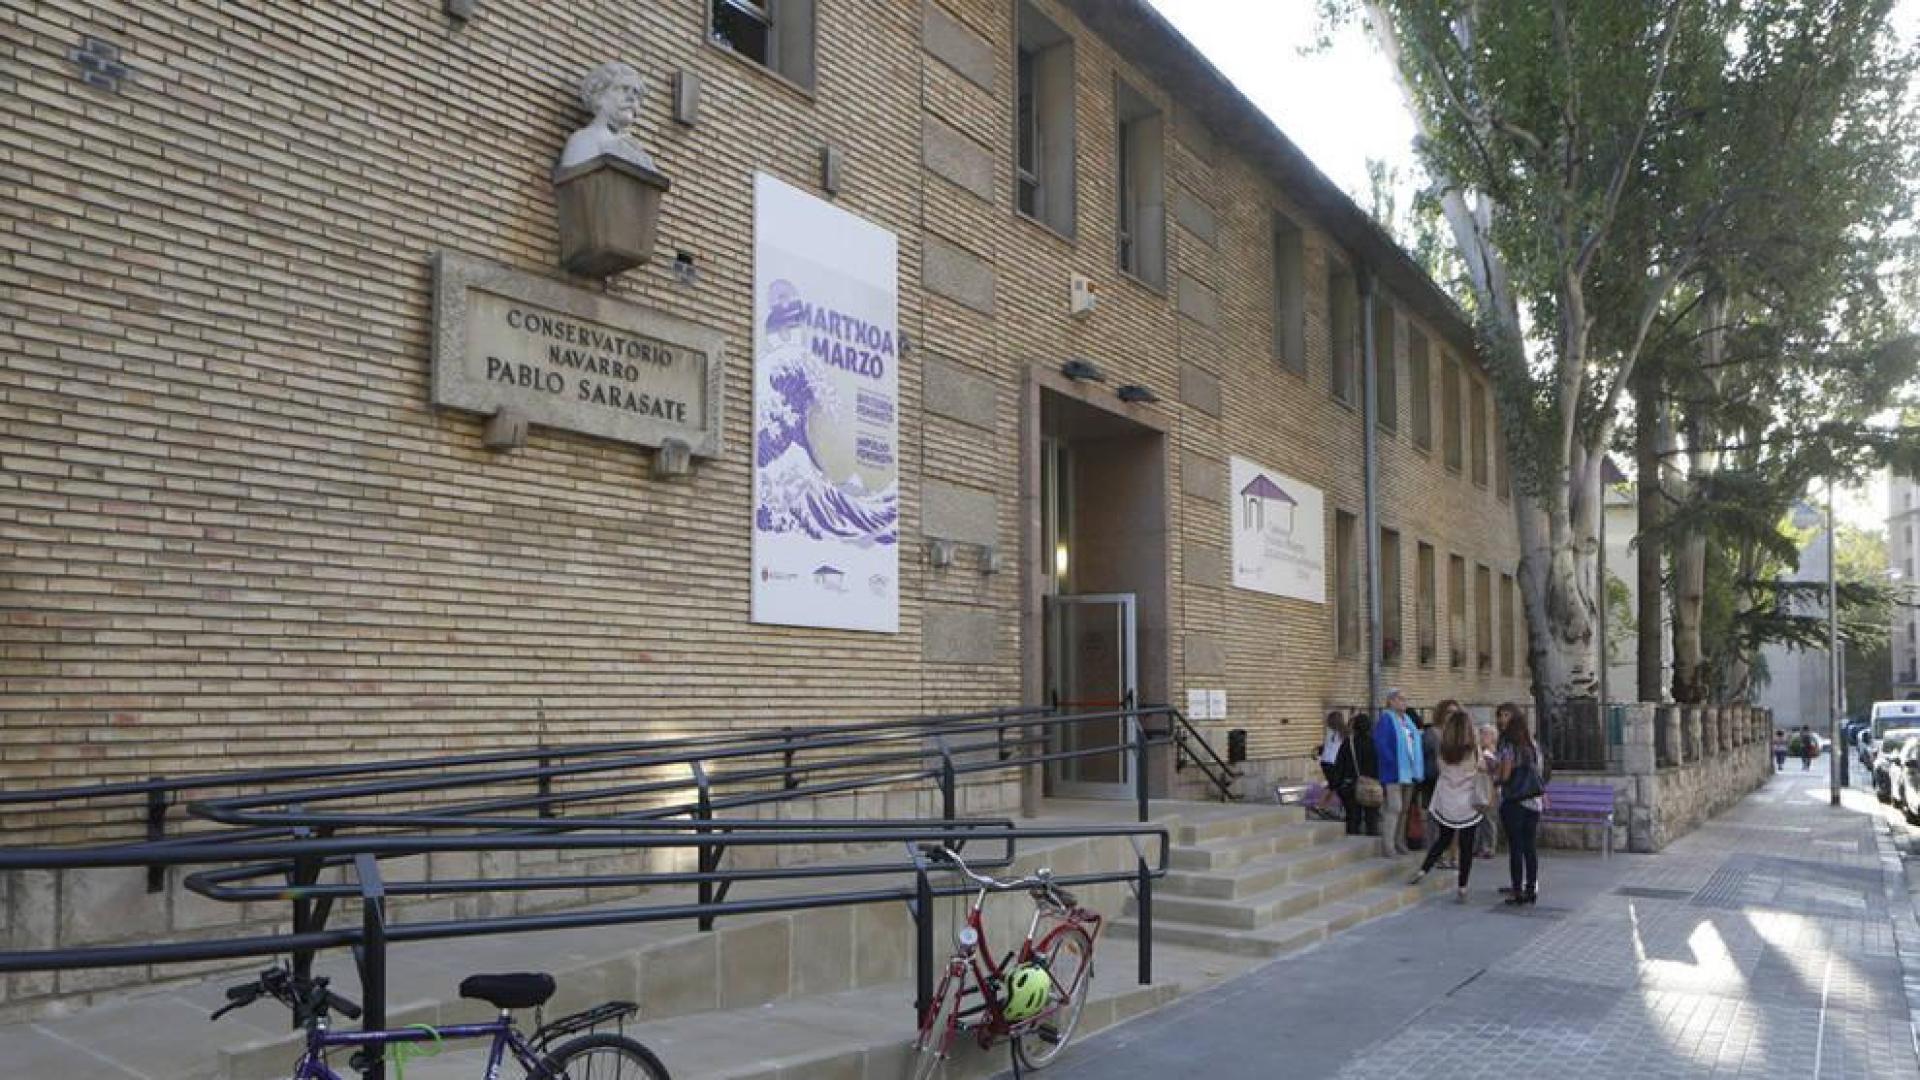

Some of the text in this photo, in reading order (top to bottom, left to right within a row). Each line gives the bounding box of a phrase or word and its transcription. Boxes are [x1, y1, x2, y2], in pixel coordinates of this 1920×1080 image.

[506, 309, 672, 367] CONSERVATORIO
[799, 302, 894, 357] MARTXOA
[812, 335, 883, 378] MARZO
[486, 356, 686, 423] PABLO SARASATE
[548, 345, 639, 382] NAVARRO
